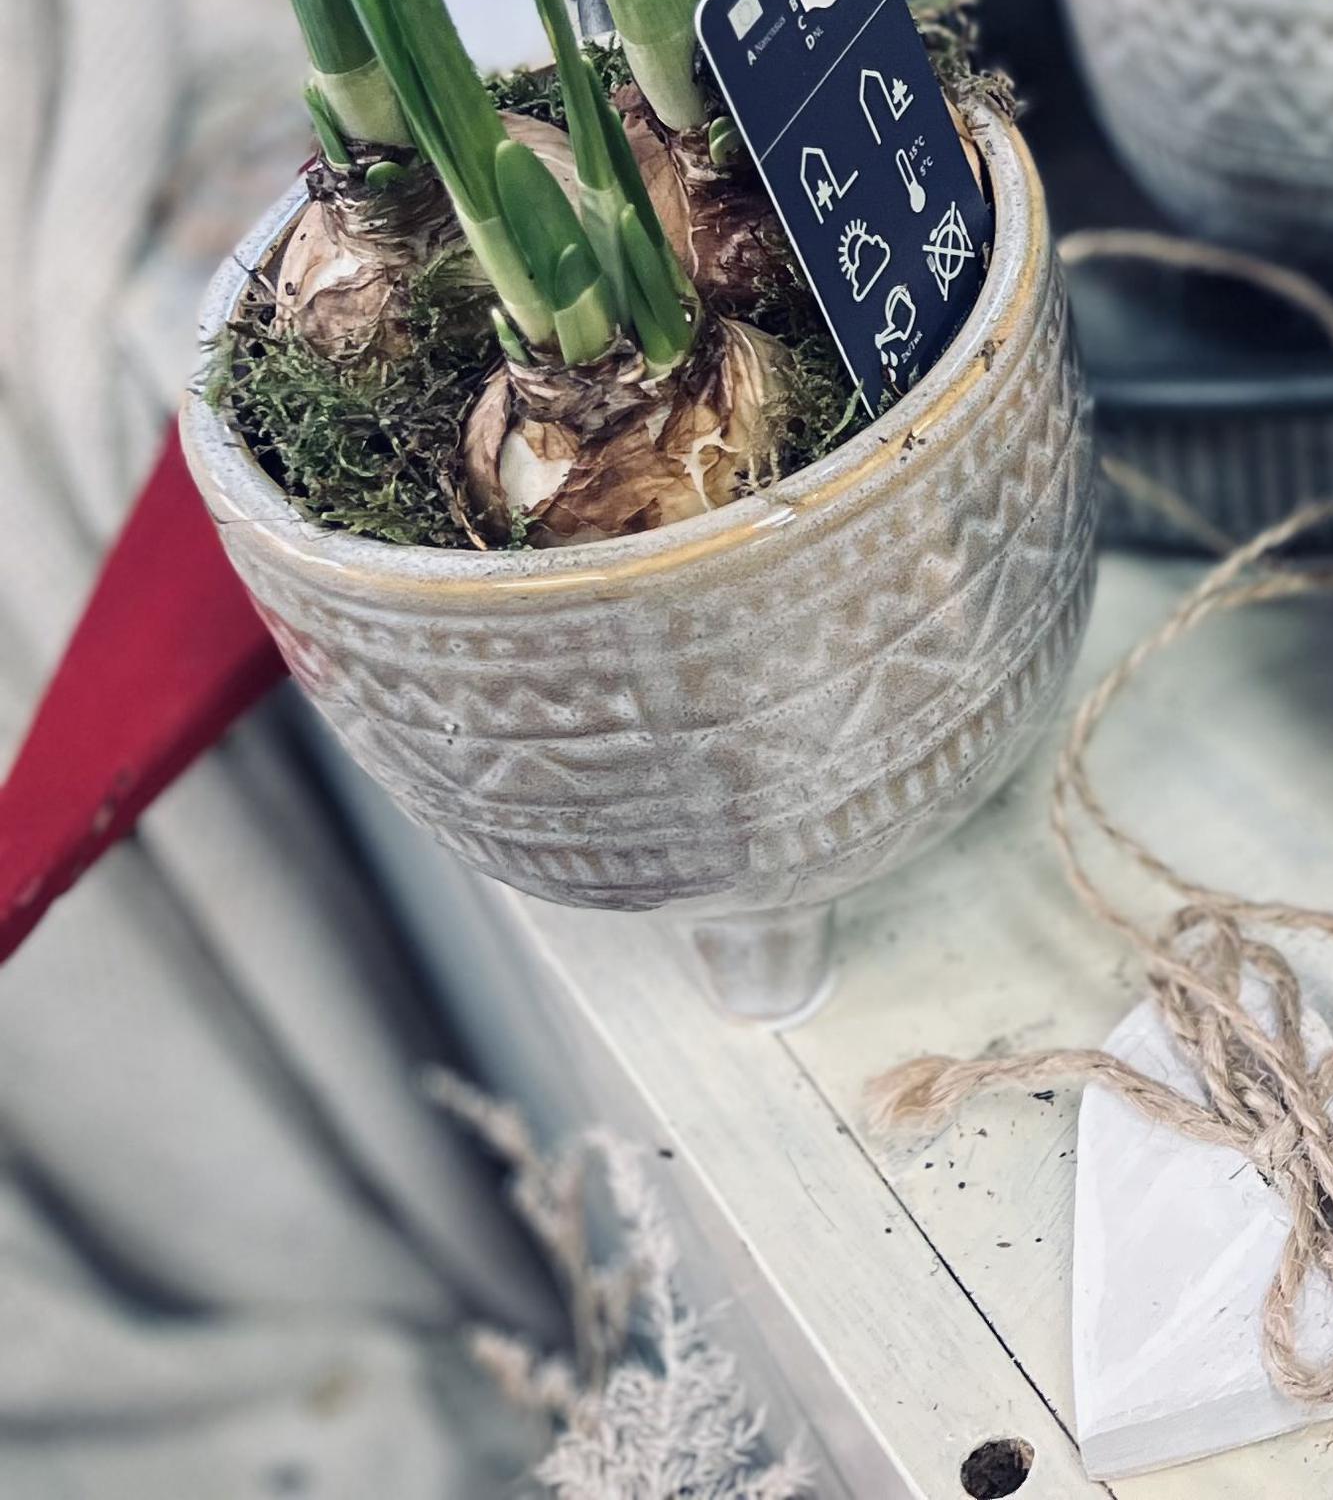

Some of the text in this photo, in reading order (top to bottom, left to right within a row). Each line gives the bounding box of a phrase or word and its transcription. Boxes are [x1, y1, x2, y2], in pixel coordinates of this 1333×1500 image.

[797, 15, 807, 30] C
[805, 33, 815, 50] D
[747, 49, 757, 66] A
[920, 155, 934, 177] 5°C
